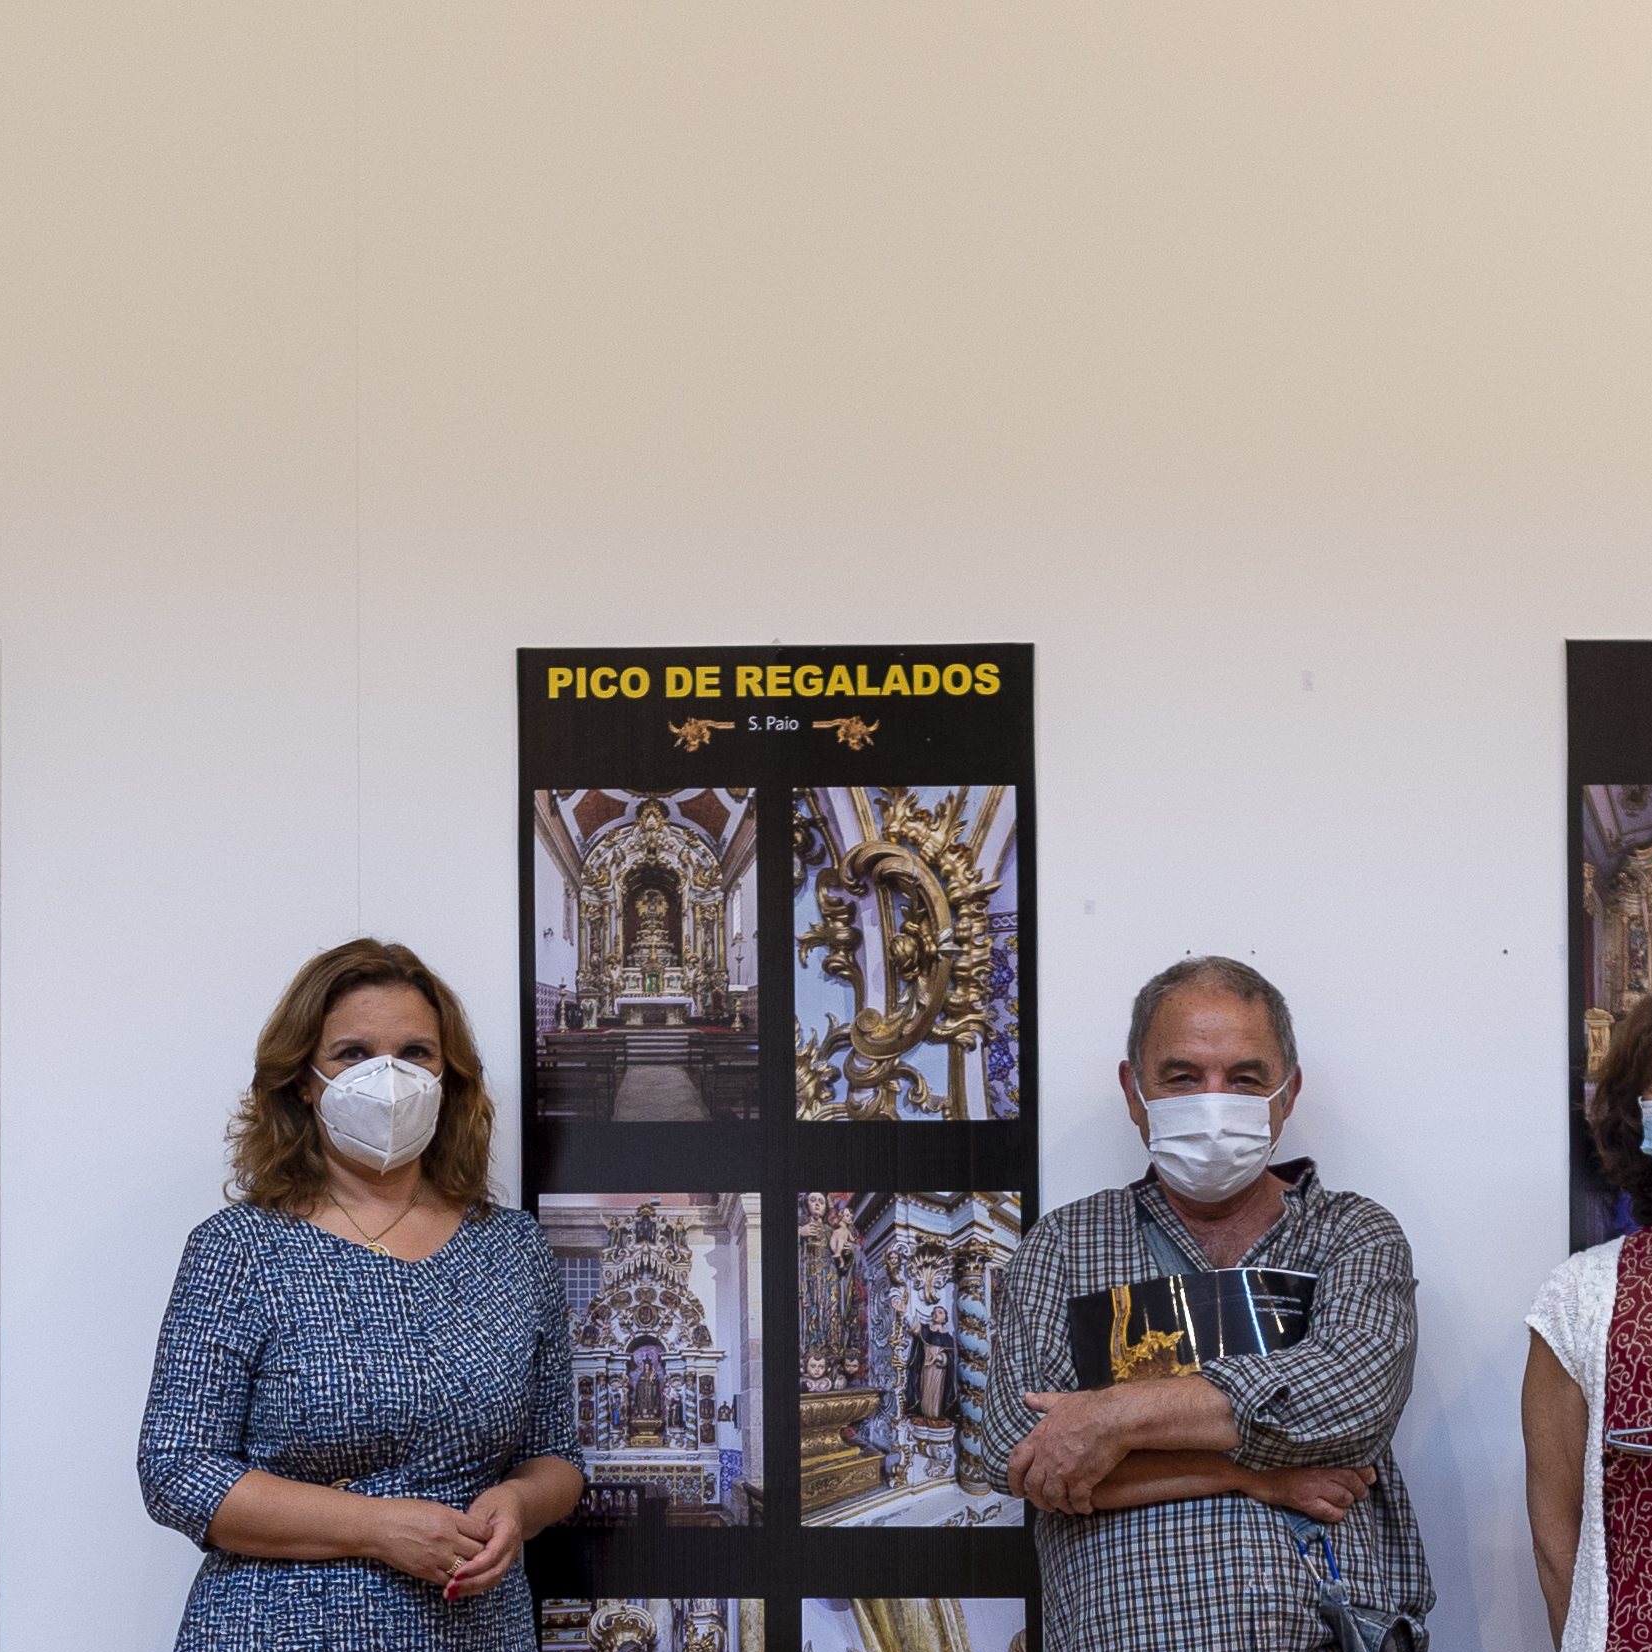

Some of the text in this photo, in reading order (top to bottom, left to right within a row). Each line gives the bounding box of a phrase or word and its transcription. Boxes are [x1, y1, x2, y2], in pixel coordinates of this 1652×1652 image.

[548, 663, 1001, 700] PICO DE REGALADOS
[748, 715, 799, 731] S. Paio
